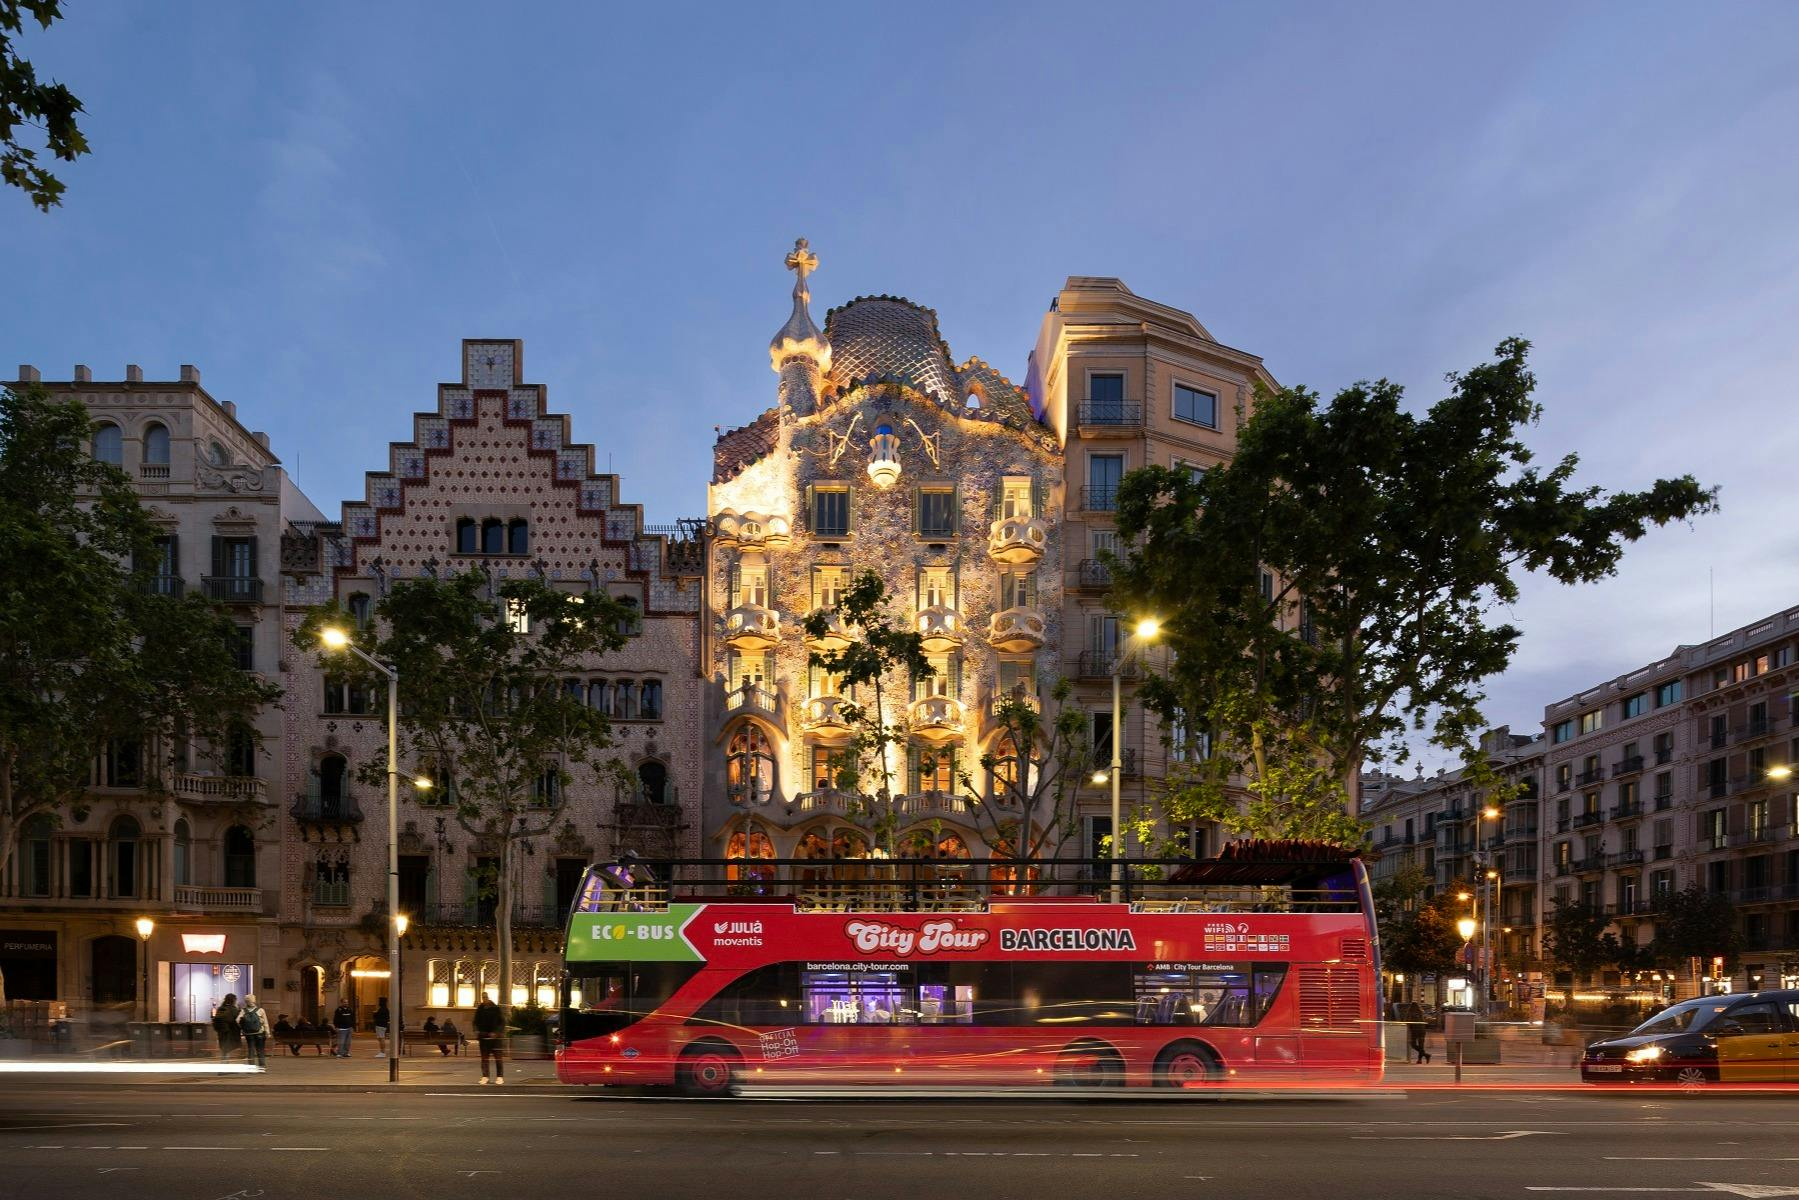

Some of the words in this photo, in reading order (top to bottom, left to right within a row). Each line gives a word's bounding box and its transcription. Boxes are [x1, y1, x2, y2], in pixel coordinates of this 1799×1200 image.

[848, 921, 914, 953] City
[919, 921, 986, 951] Tour
[1000, 928, 1137, 951] BARCELONA
[4, 942, 53, 951] PERFUMERIA
[807, 962, 909, 972] barcelona.city-tour.com
[1174, 963, 1187, 971] City
[760, 1030, 797, 1042] OFFICIAL
[761, 1038, 797, 1051] Hop-On
[763, 1045, 800, 1059] Hop-Off
